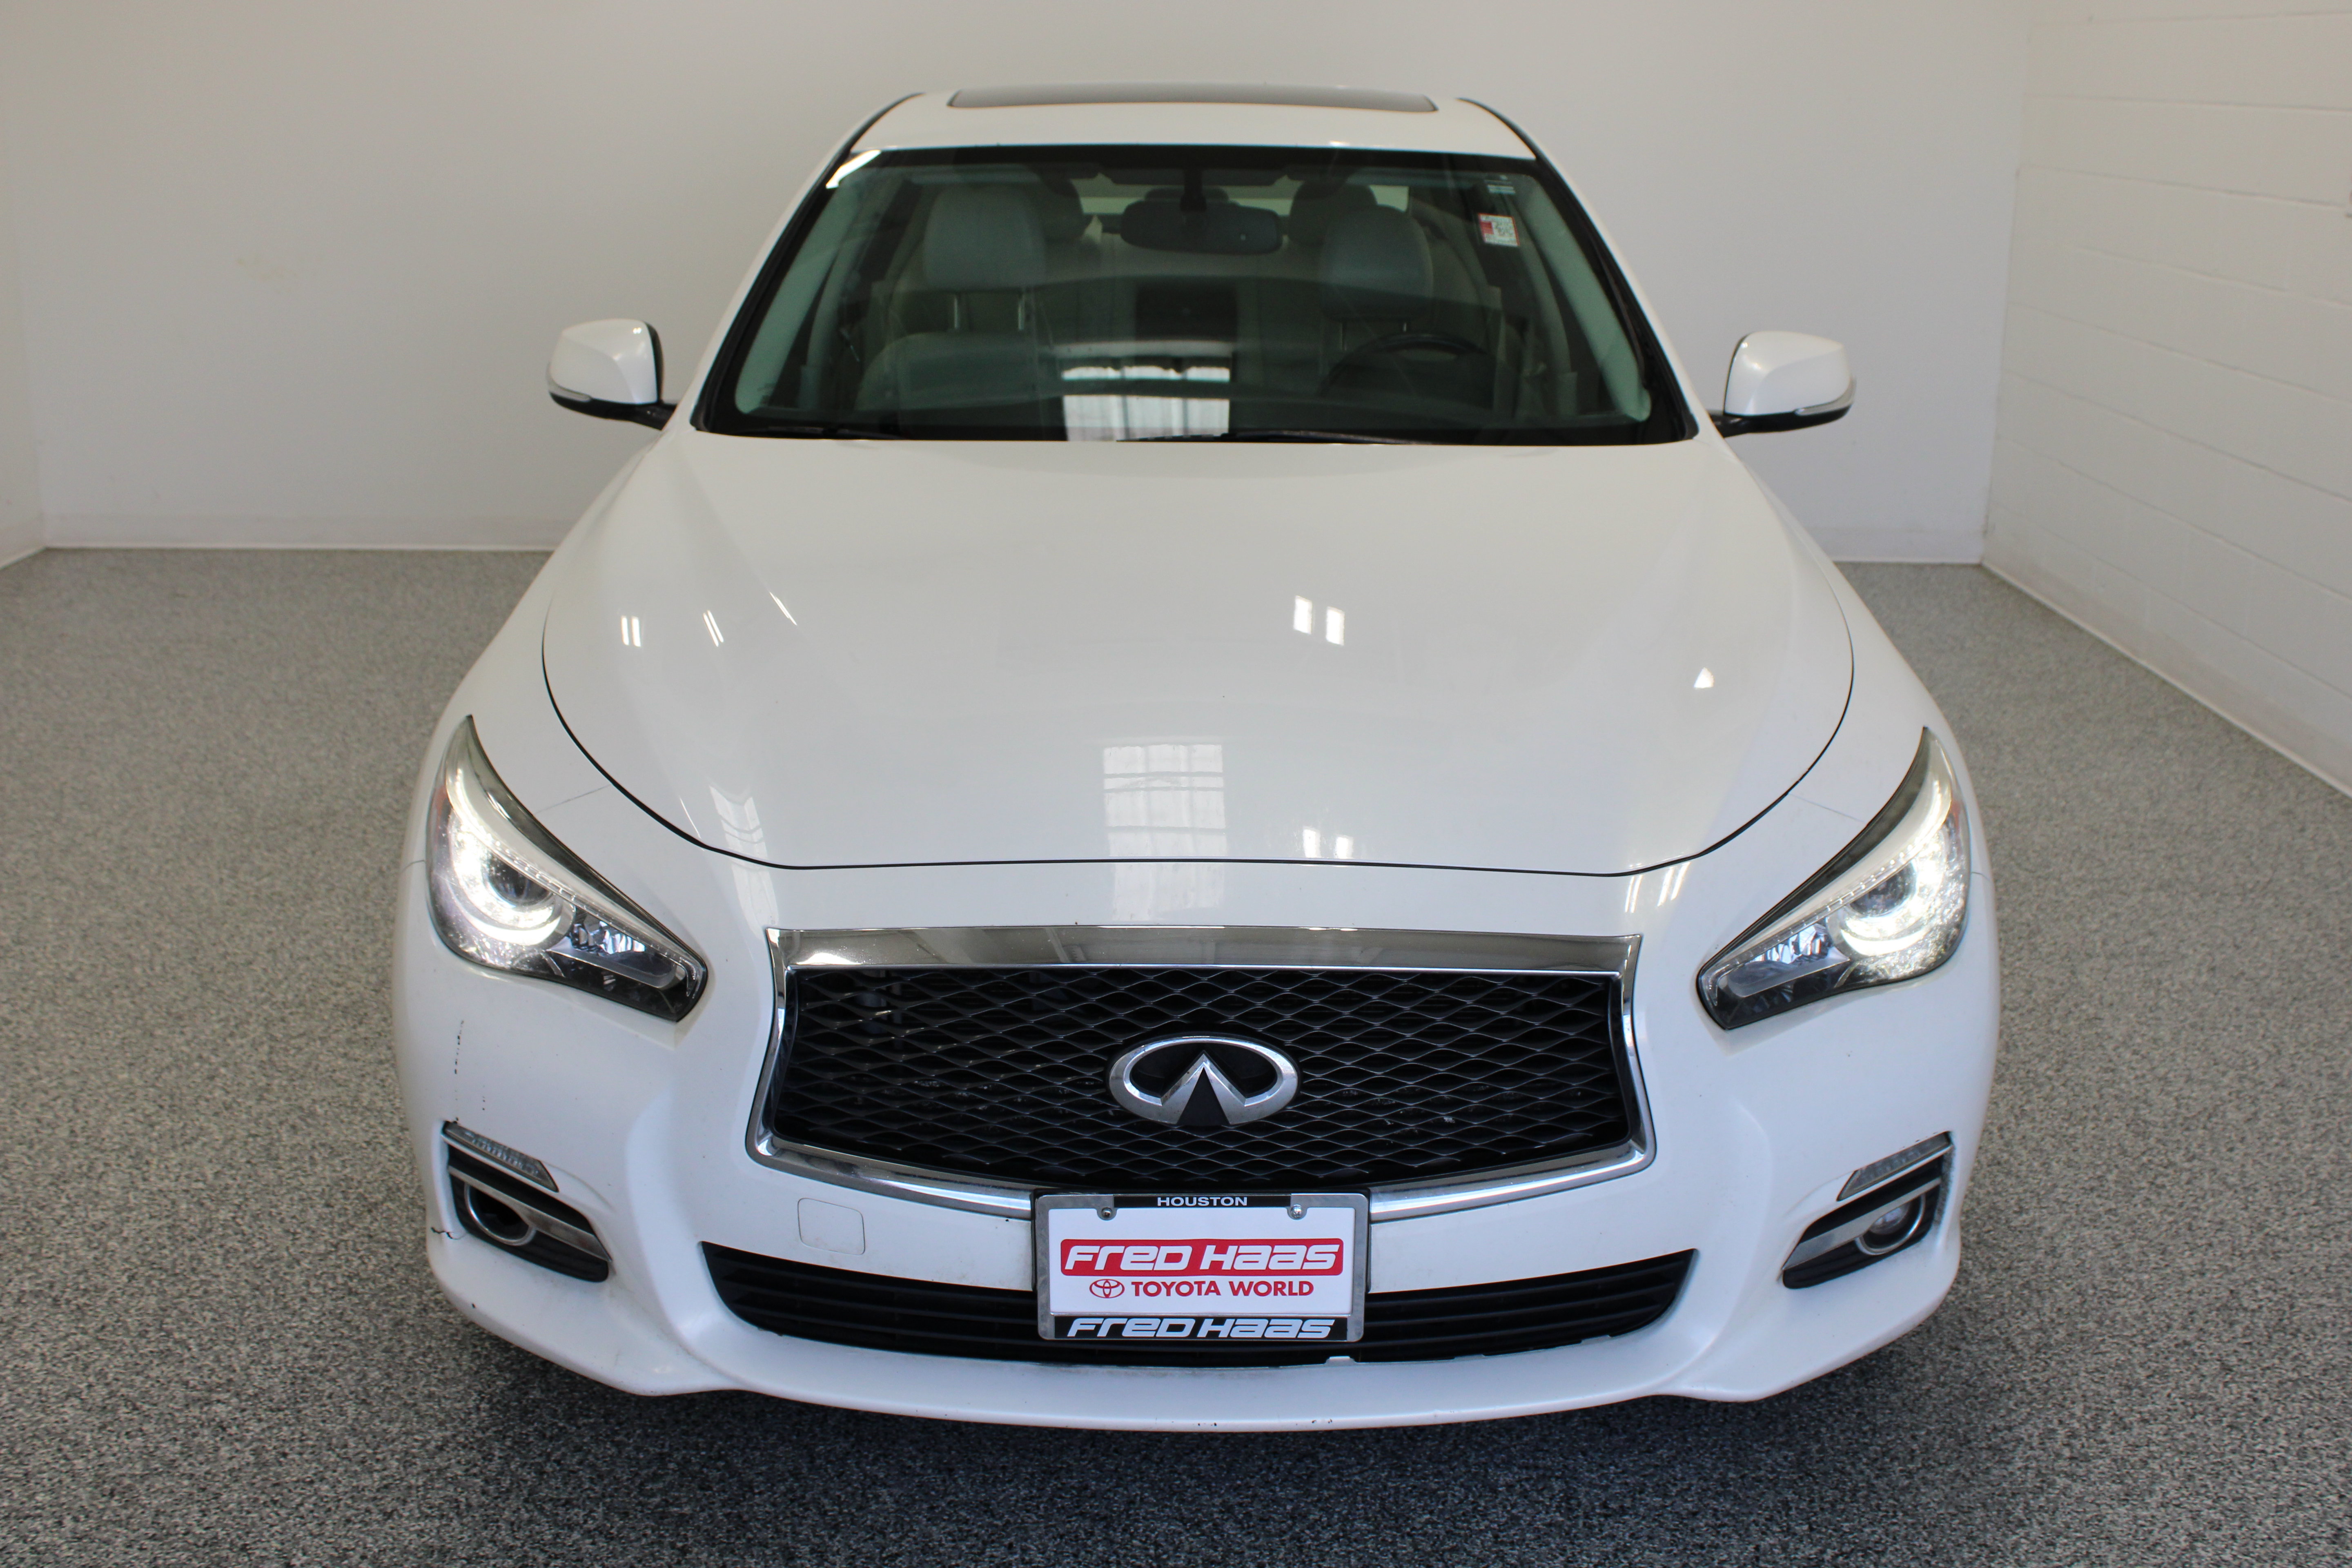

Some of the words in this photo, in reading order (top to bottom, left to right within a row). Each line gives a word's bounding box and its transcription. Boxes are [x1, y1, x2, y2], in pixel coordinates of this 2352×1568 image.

[1157, 1196, 1248, 1207] HOUSTON
[1131, 1281, 1221, 1297] TOYOTA
[1229, 1281, 1314, 1296] WORLD
